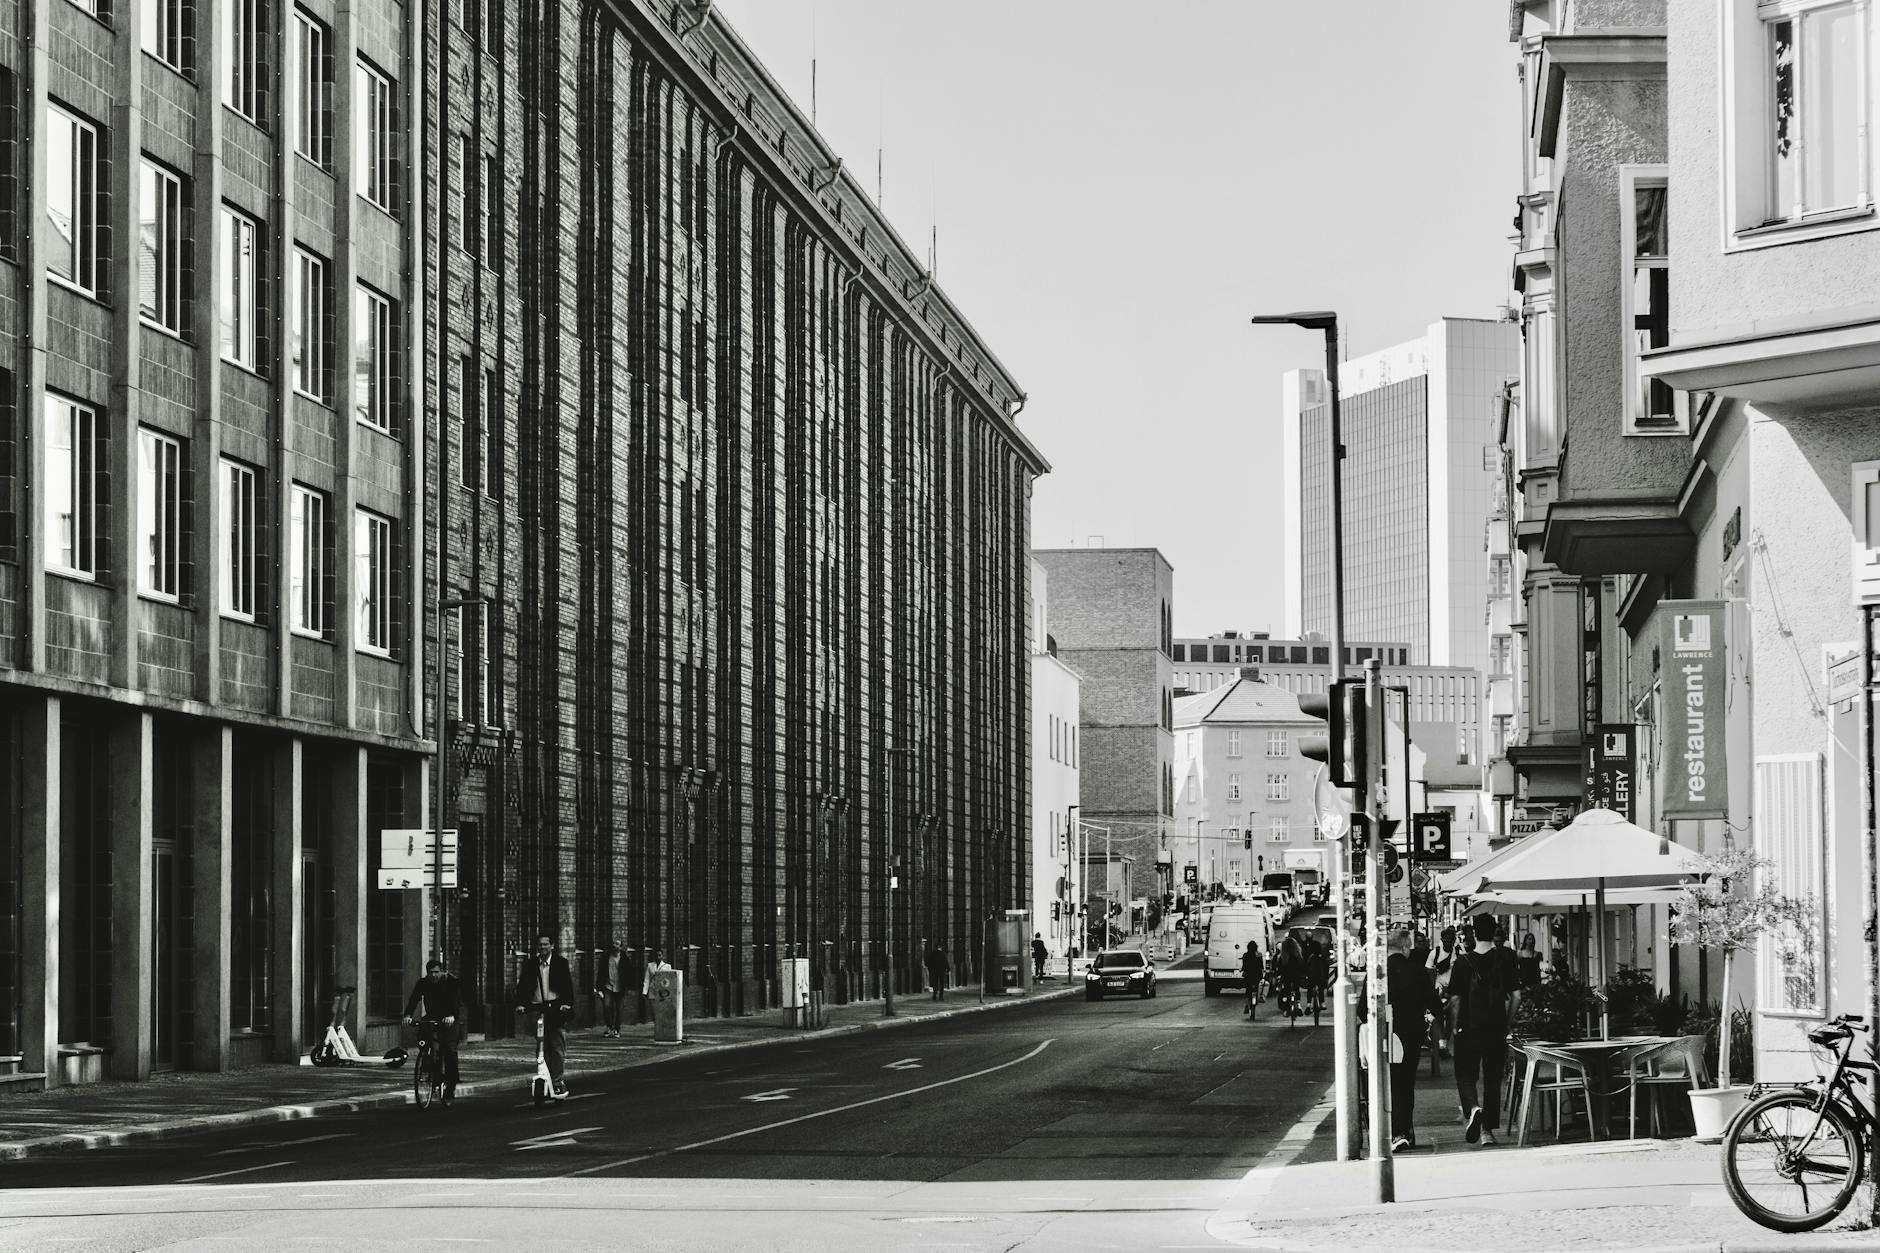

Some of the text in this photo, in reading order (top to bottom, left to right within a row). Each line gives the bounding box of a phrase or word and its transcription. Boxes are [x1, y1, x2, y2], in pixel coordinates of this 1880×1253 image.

[1681, 663, 1706, 802] restaurant
[1511, 824, 1537, 833] PIZZA
[1423, 825, 1441, 851] P
[1186, 870, 1195, 880] P
